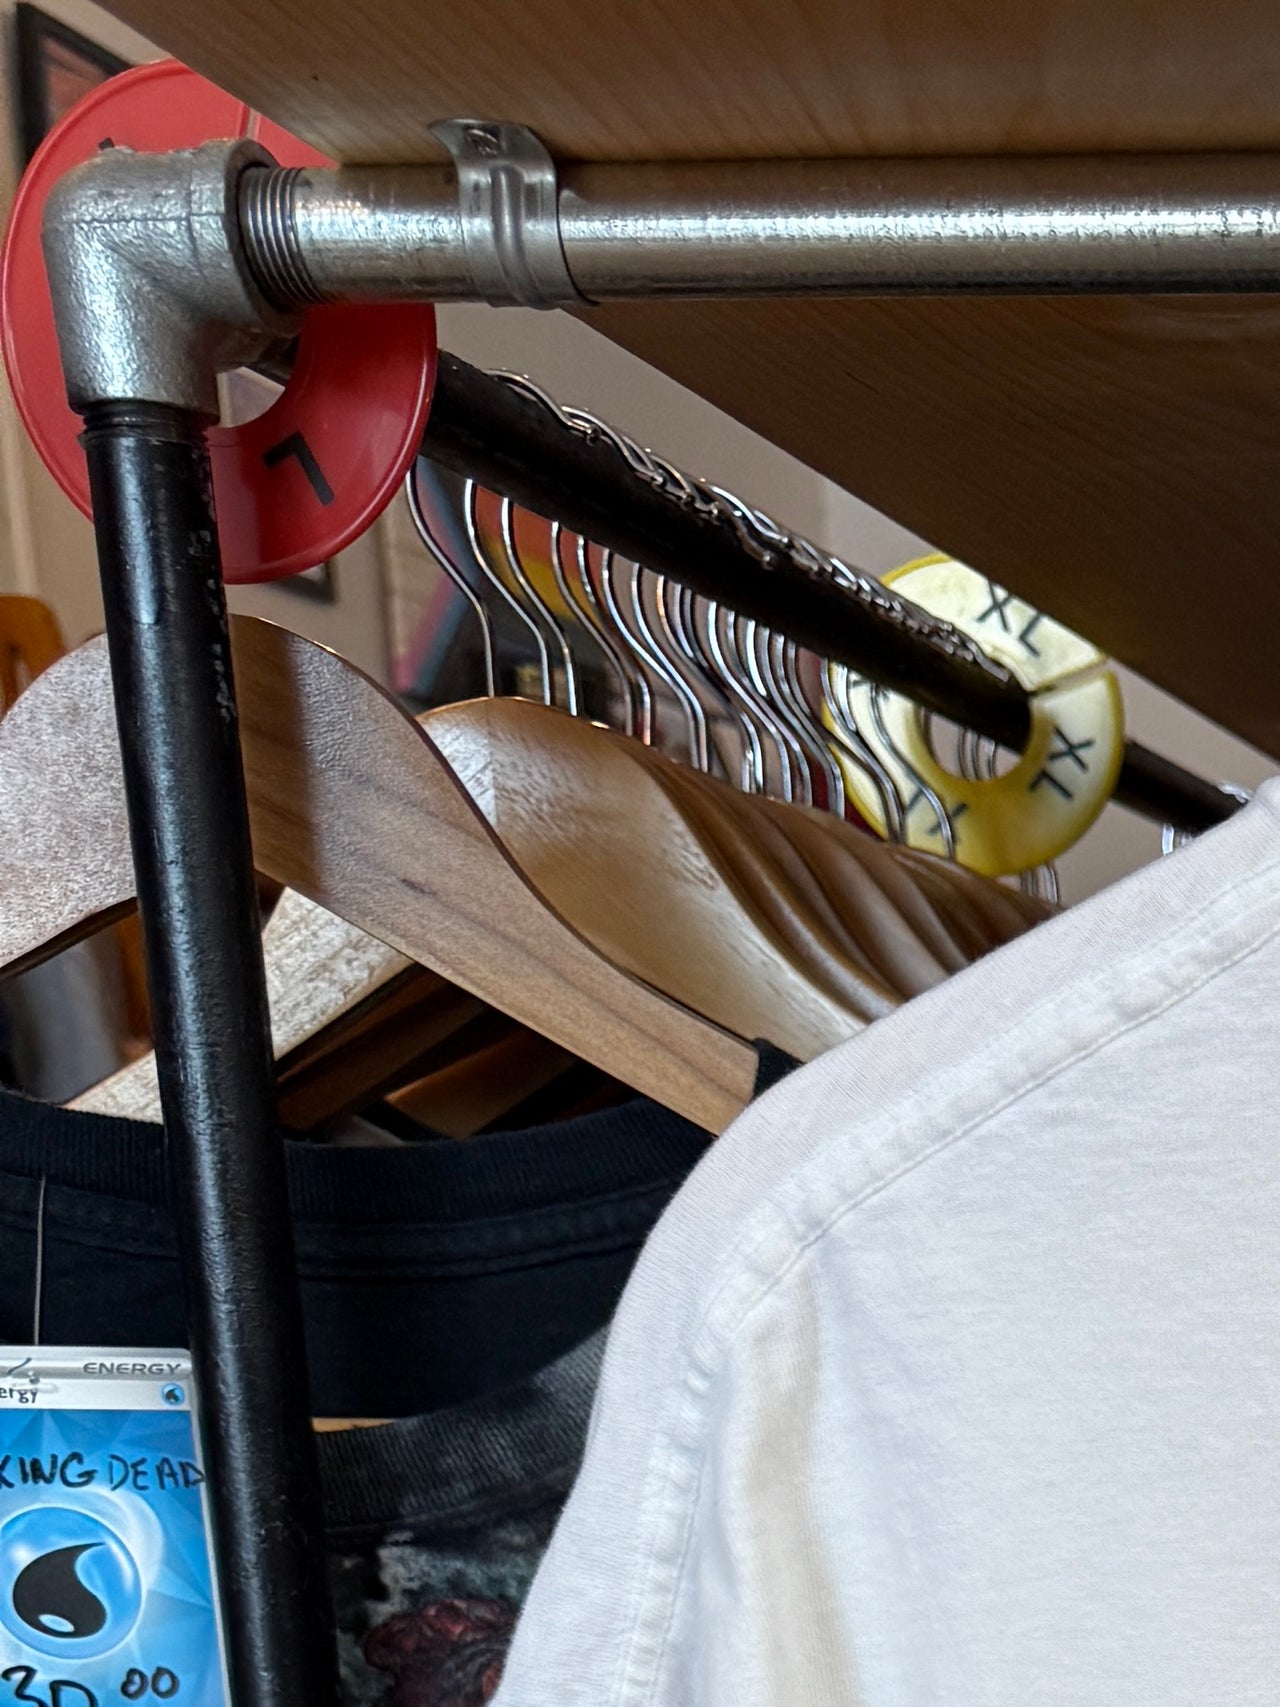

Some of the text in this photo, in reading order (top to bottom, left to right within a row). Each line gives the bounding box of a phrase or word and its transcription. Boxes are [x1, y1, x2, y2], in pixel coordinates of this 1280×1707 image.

[976, 581, 1042, 658] XL
[1028, 725, 1097, 800] XL
[82, 1361, 183, 1376] ENERGY
[108, 1453, 207, 1492] DEAD
